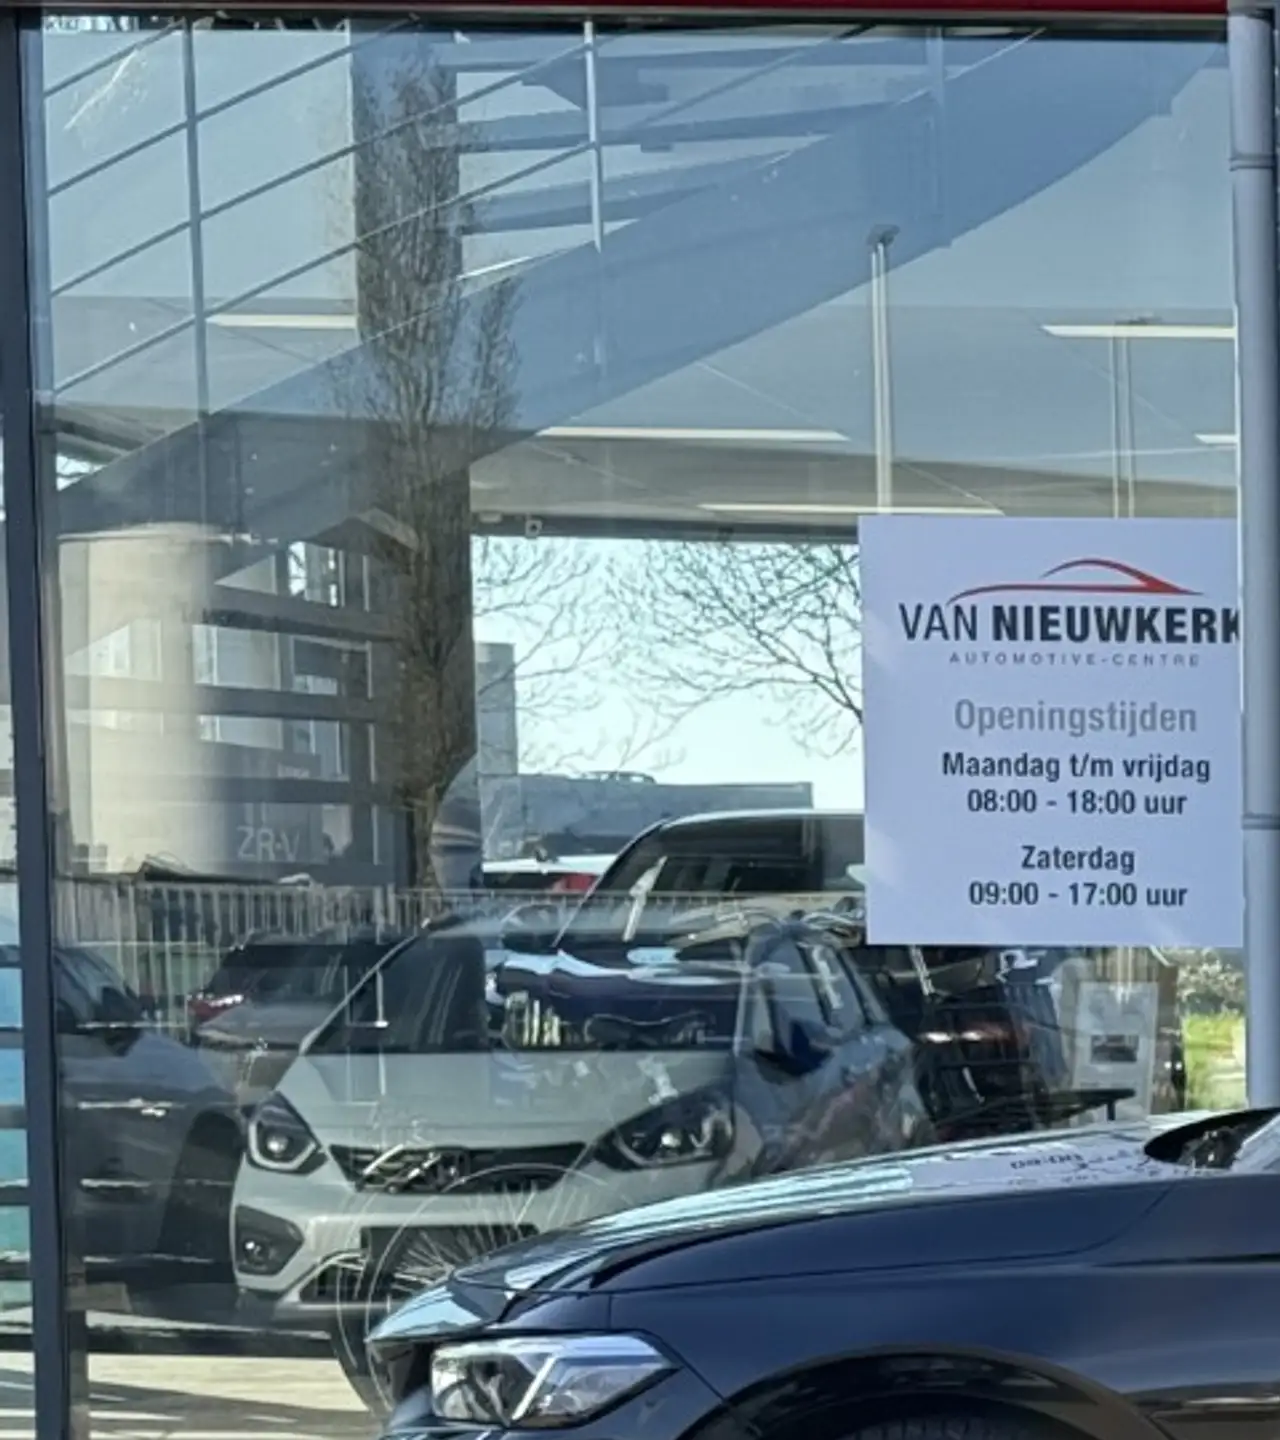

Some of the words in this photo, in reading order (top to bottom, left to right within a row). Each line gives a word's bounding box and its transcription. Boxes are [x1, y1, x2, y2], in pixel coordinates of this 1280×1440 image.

[900, 603, 977, 641] VAN
[992, 605, 1240, 644] NIEUWKERK
[950, 652, 1200, 667] AUTOMOTIVE-CENTRE
[954, 699, 1197, 737] Openingstijden
[943, 752, 1060, 782] Maandag
[1070, 754, 1113, 778] t/m
[1123, 755, 1211, 784] vrijdag
[967, 789, 1037, 814] 08:00
[1068, 790, 1136, 815] 18:00
[1145, 795, 1188, 815] uur
[1021, 845, 1136, 875] Zaterdag
[969, 881, 1039, 906] 09:00
[1069, 882, 1137, 907] 17:00
[1146, 887, 1188, 906] uur
